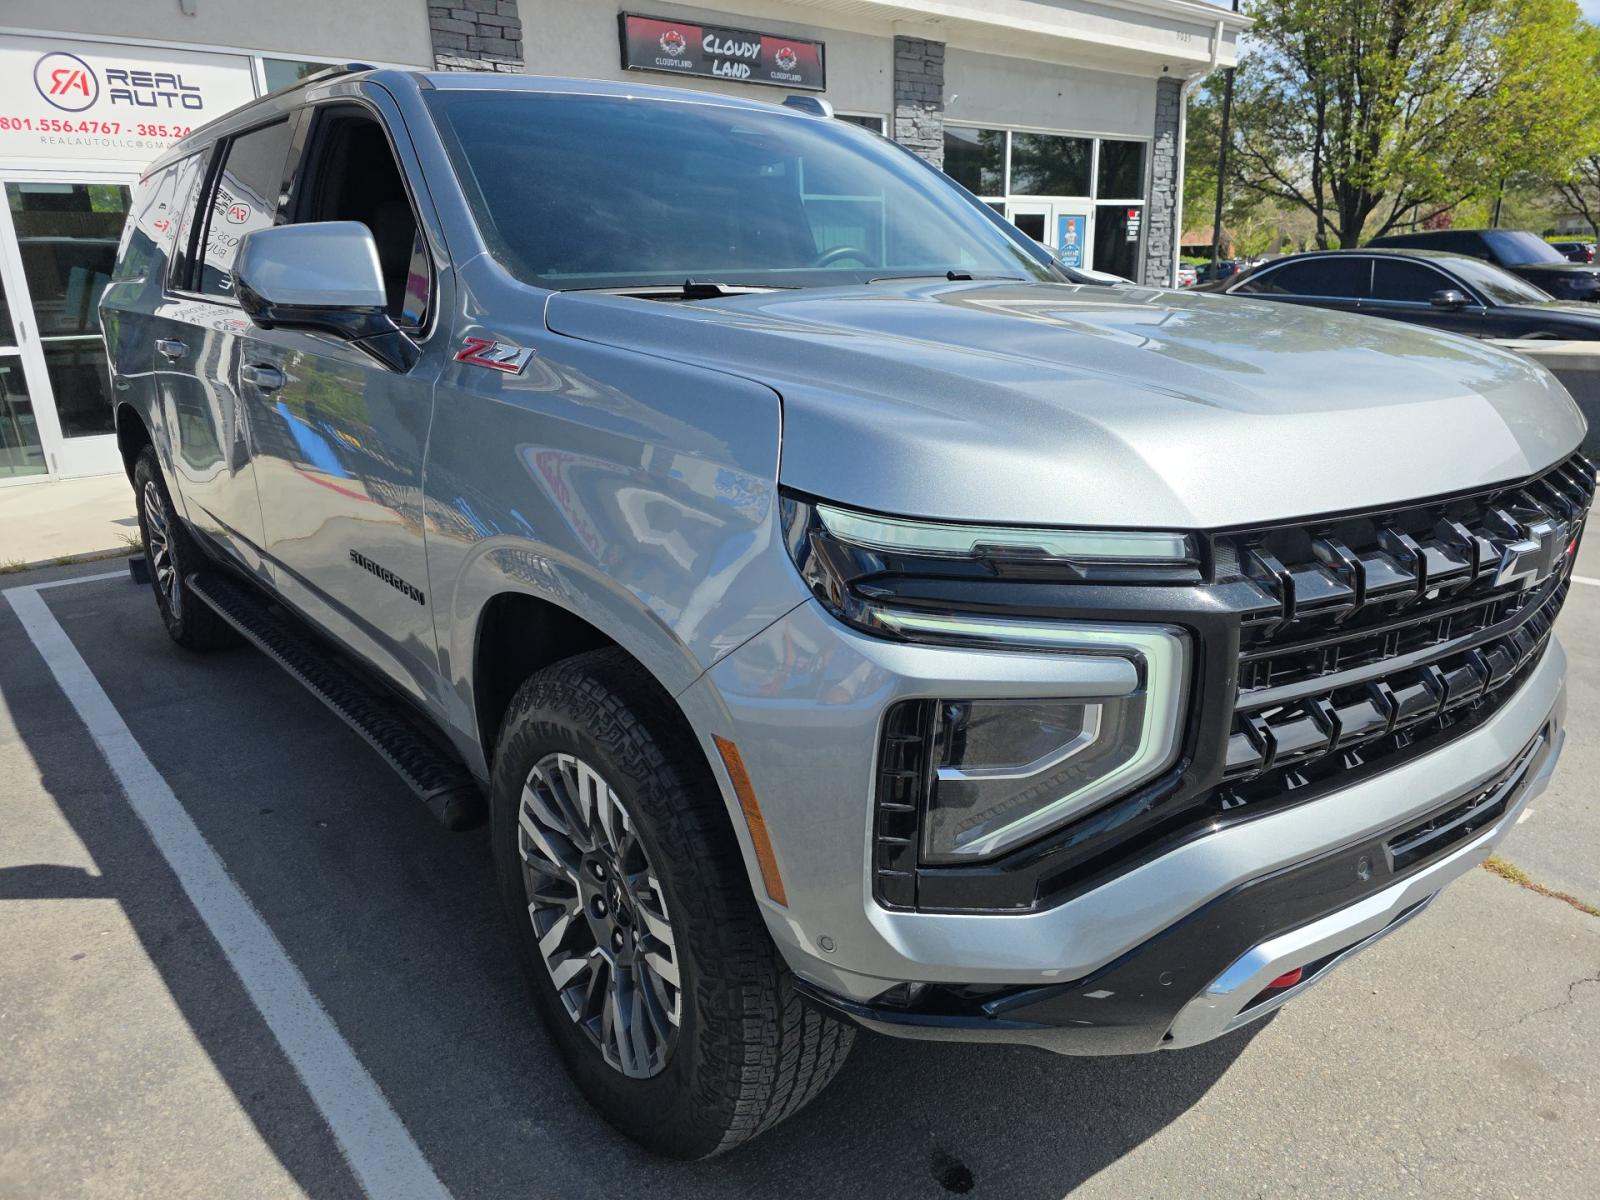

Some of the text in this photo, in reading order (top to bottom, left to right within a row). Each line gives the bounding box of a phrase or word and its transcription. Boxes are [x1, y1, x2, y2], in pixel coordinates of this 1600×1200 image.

[702, 34, 760, 59] CLOUDY
[655, 57, 693, 69] CLOUDYLAND
[712, 60, 751, 79] LAND
[105, 68, 200, 92] REAL
[770, 71, 802, 82] CLOUDYLAND
[109, 88, 204, 111] AUTO
[0, 117, 121, 135] 801.556.4767
